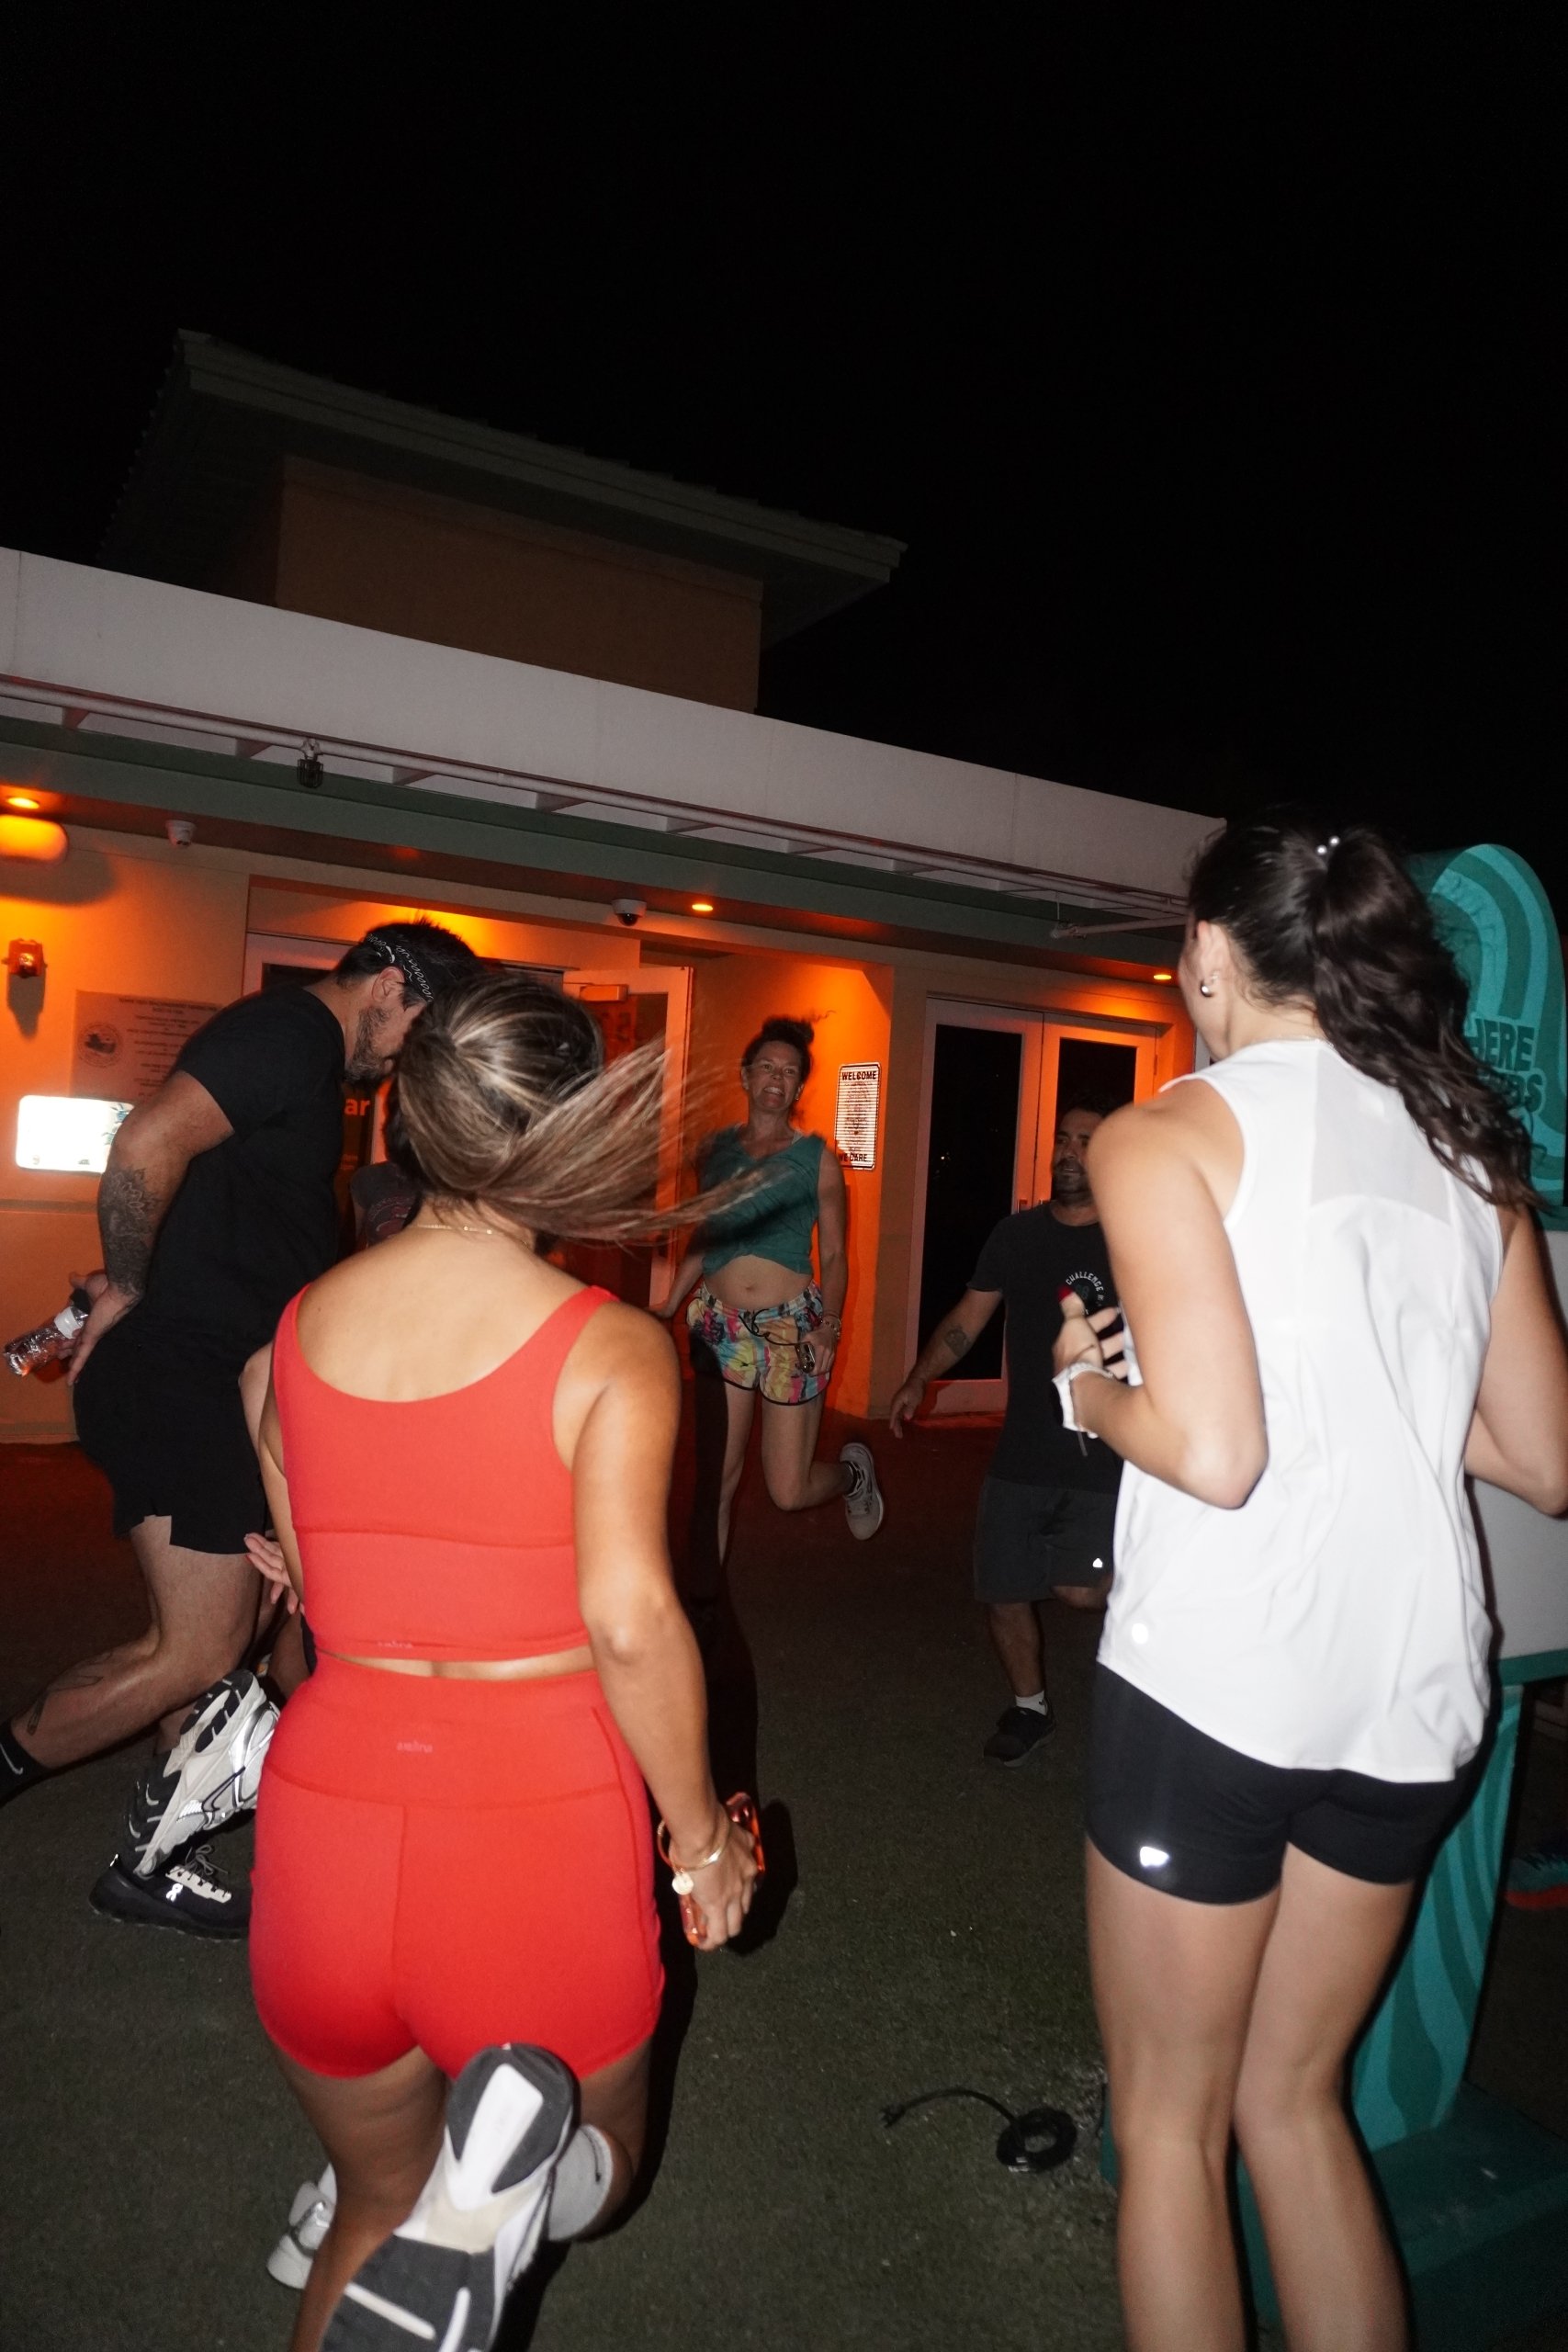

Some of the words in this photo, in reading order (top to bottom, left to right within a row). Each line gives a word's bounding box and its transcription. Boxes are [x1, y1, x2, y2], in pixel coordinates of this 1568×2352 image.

[841, 1070, 877, 1080] WELCOME
[344, 1098, 371, 1115] ar
[850, 1153, 867, 1162] CARE
[1066, 1272, 1103, 1292] CHALLENGE
